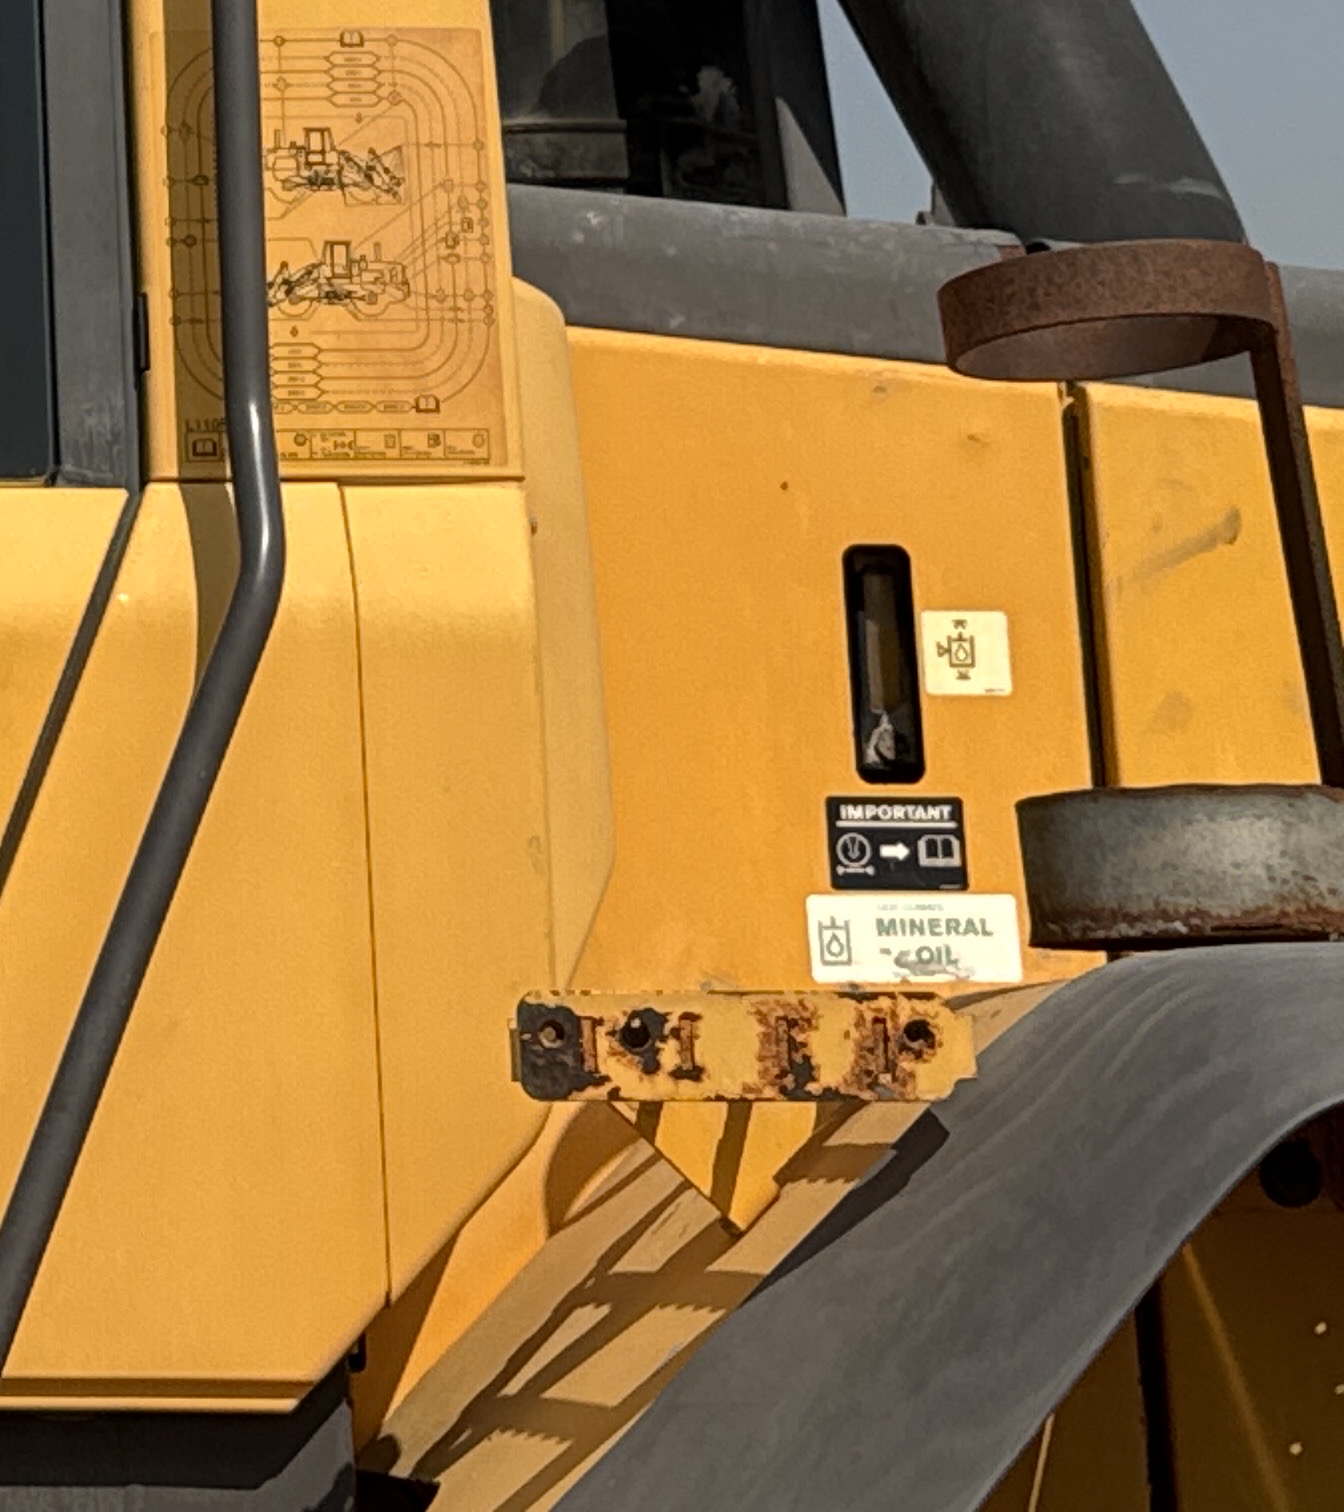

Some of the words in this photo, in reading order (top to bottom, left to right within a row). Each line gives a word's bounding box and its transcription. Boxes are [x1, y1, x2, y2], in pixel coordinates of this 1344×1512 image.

[839, 804, 953, 820] IMPORTANT
[874, 917, 994, 937] MINERAL
[915, 943, 959, 966] OIL
